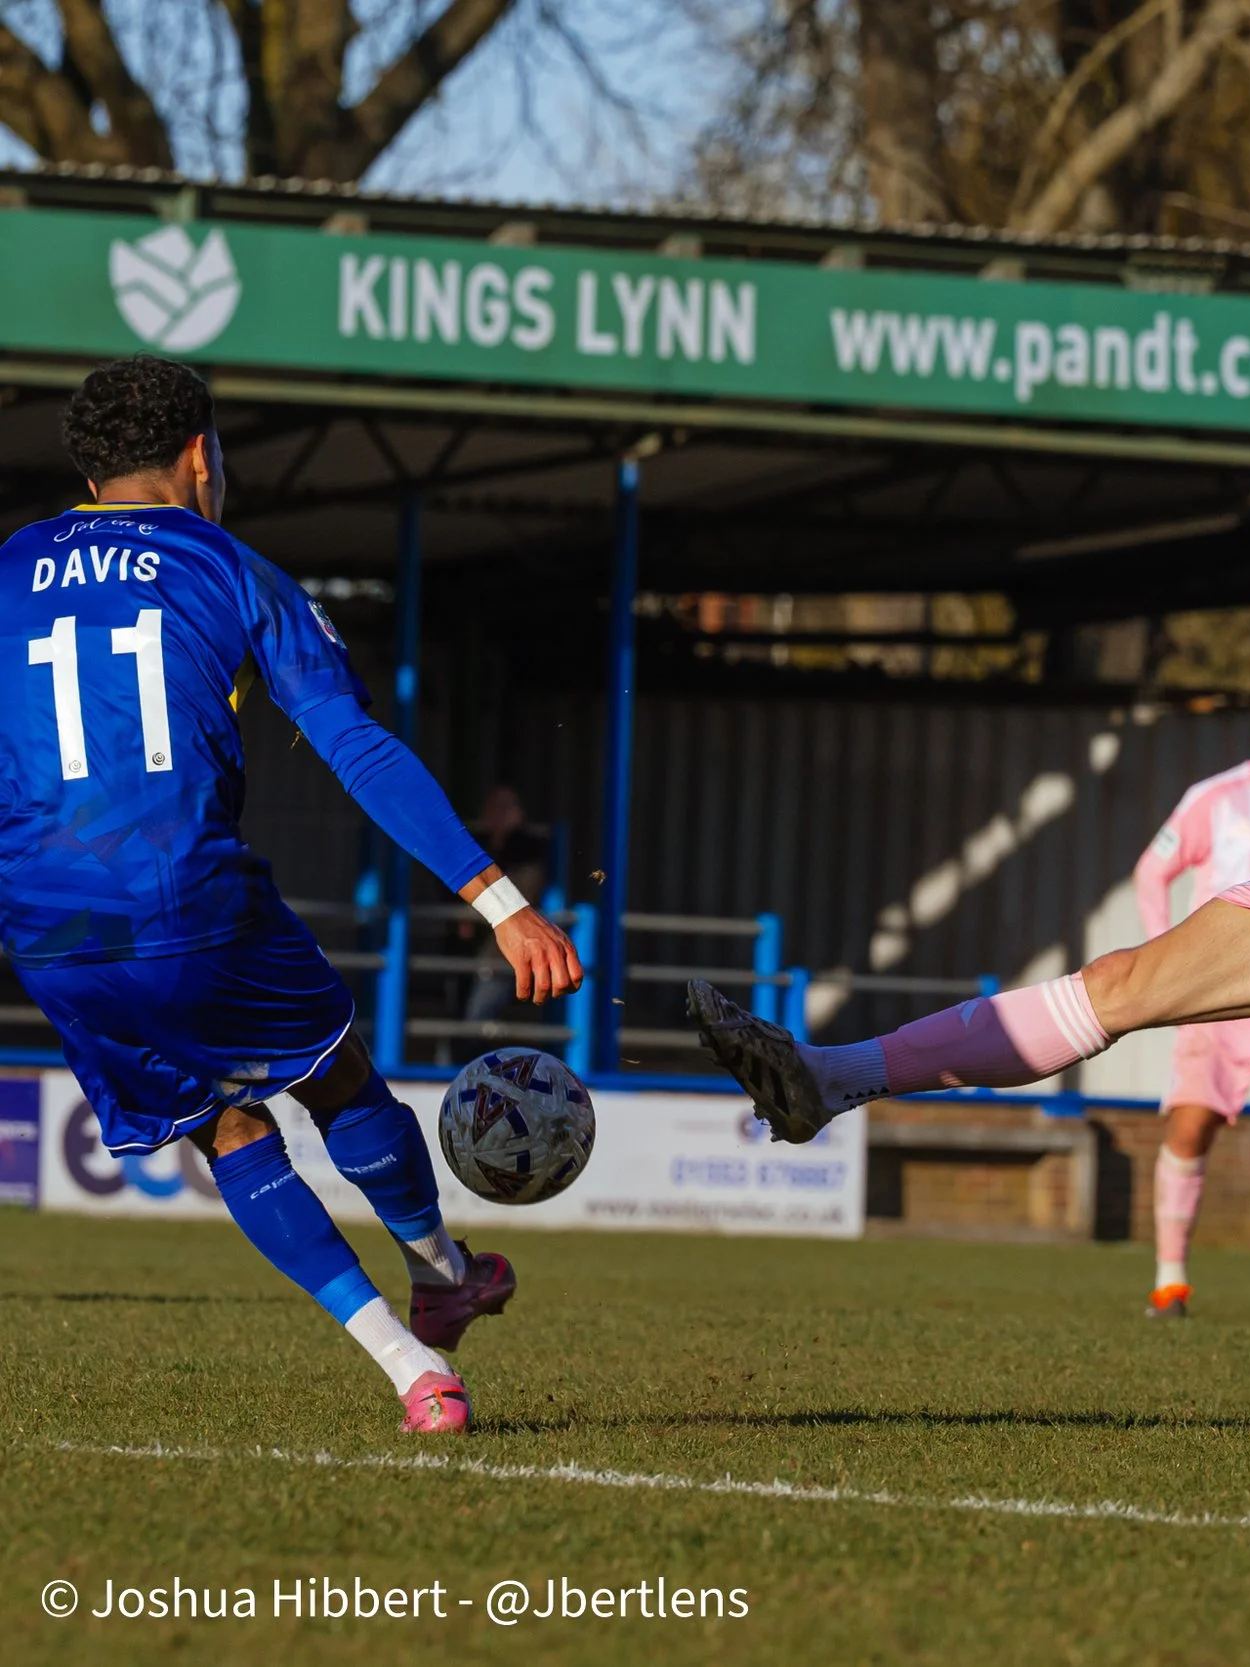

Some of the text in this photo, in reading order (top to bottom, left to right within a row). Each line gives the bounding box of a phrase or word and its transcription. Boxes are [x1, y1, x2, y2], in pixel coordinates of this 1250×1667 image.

[339, 253, 757, 365] KINGS LYNN
[32, 545, 160, 592] DAVIS
[28, 608, 173, 781] 11
